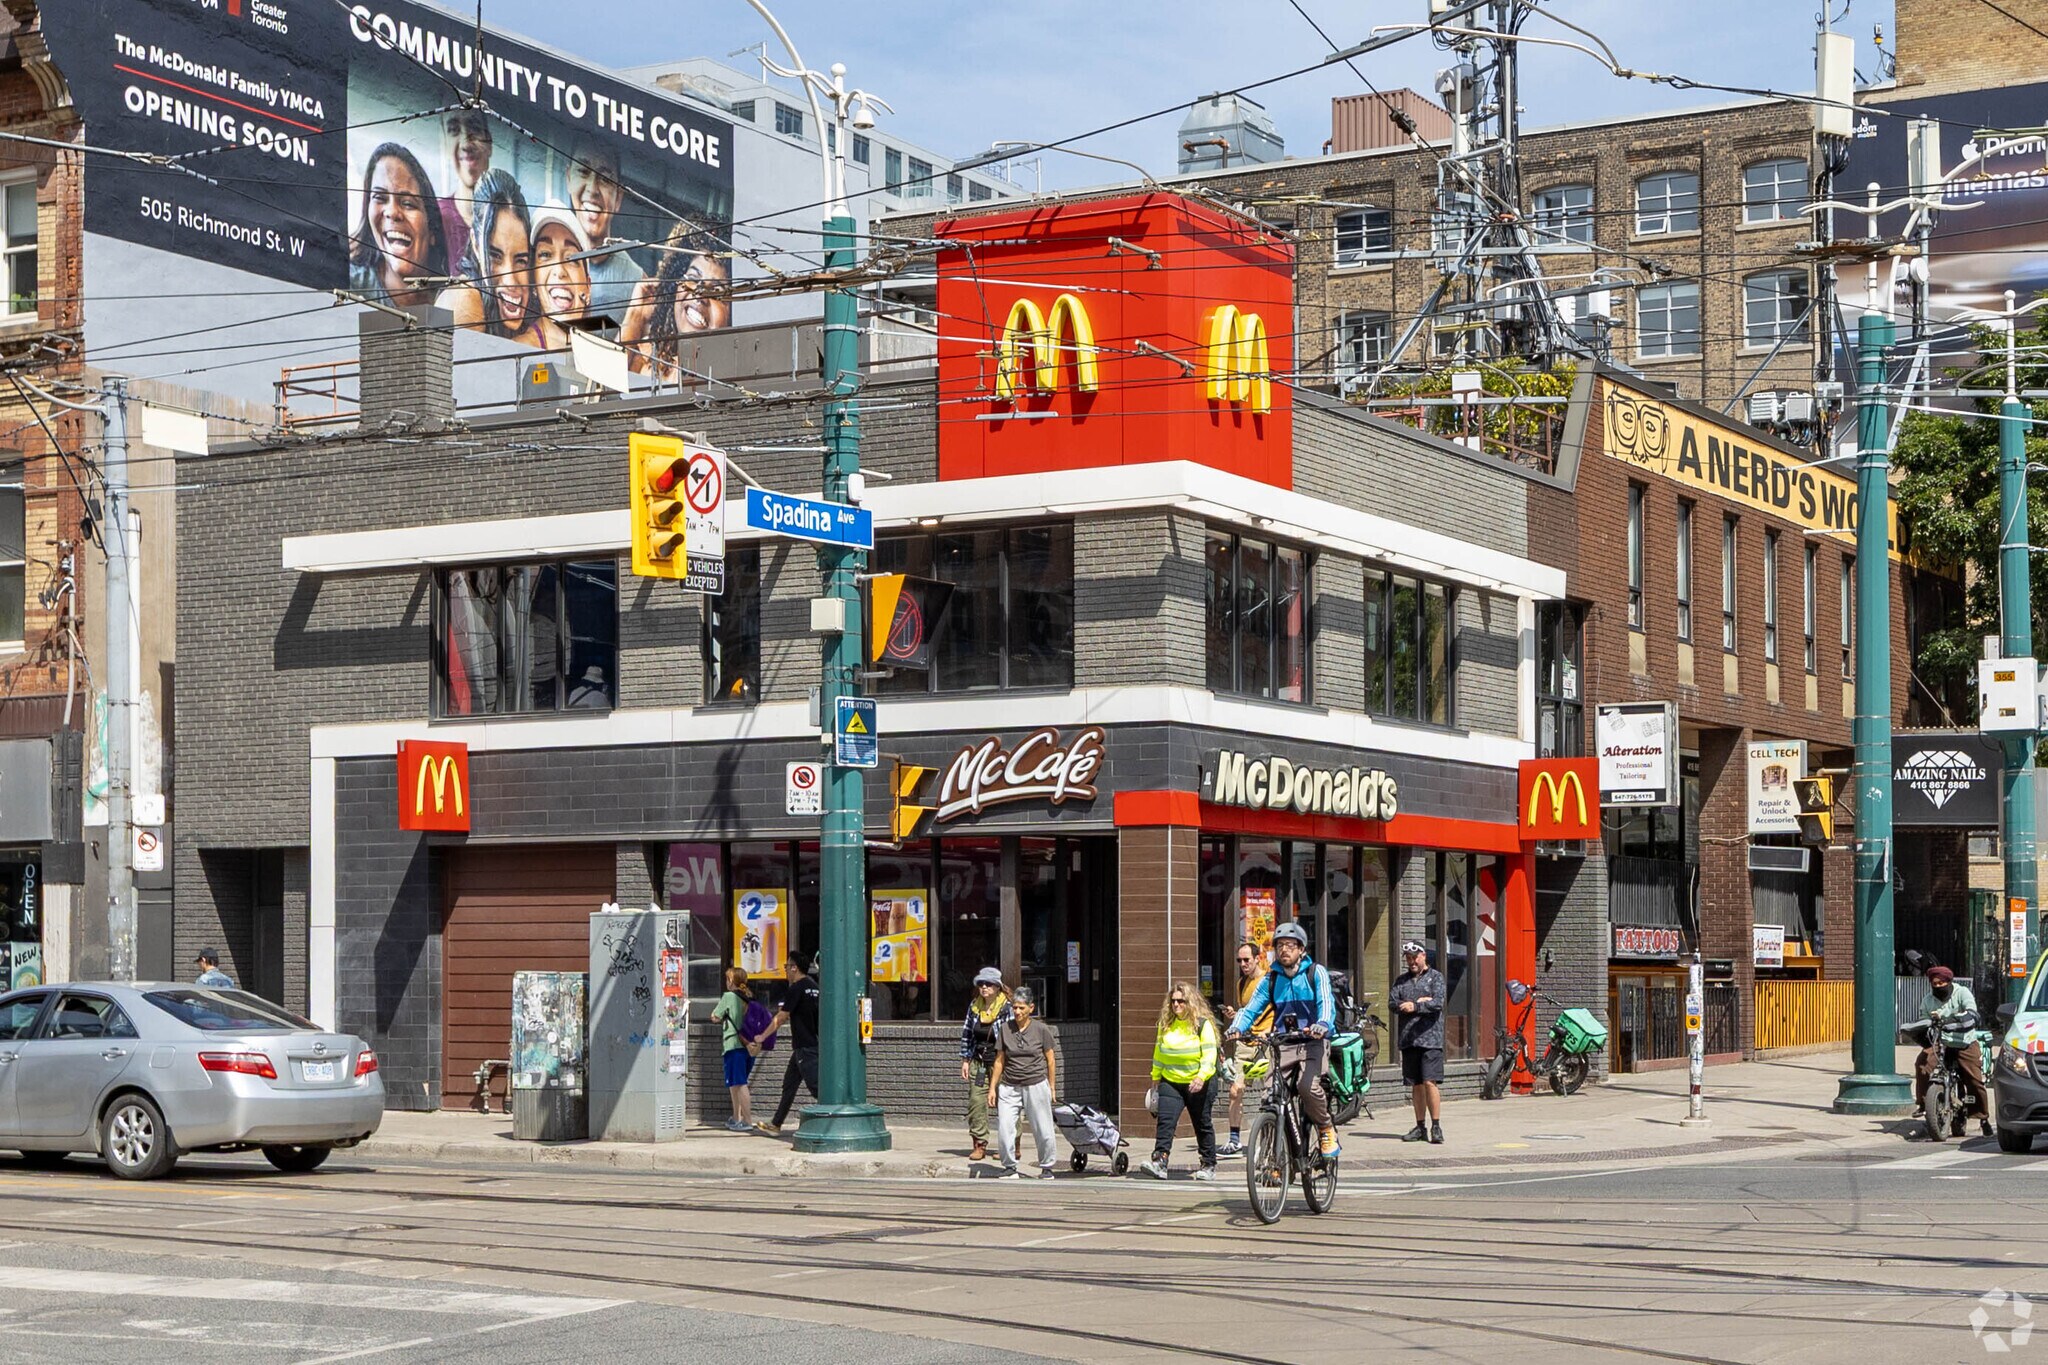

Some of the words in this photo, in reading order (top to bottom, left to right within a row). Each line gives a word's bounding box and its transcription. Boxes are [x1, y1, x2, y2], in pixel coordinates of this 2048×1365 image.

[251, 0, 287, 20] Greater
[250, 10, 288, 34] Toronto
[114, 33, 146, 61] The
[150, 46, 226, 88] McDonald
[230, 71, 278, 106] Family
[280, 88, 324, 119] YMCA
[349, 5, 541, 103] COMMUNITY
[547, 75, 587, 118] TO
[593, 93, 644, 142] THE
[650, 116, 720, 168] CORE
[124, 85, 236, 142] OPENING
[242, 121, 315, 166] SOON.
[140, 196, 173, 223] 505
[178, 205, 260, 246] Richmond
[265, 231, 285, 252] St.
[290, 236, 305, 258] W
[1677, 426, 1703, 479] A
[1707, 435, 1816, 520] NERD'S
[762, 494, 831, 532] Spadina
[837, 508, 855, 525] Ave
[693, 561, 724, 575] VEHICLES
[685, 575, 718, 589] EXCEPTED
[840, 701, 874, 710] ATTENTION
[1602, 744, 1663, 757] Alteration
[1750, 749, 1772, 758] CELL
[1774, 748, 1799, 757] TECH
[938, 731, 1100, 815] McCafé
[1615, 761, 1653, 769] Professional
[1893, 768, 1948, 780] AMAZING
[1951, 768, 1986, 780] NAILS
[1213, 749, 1398, 822] McDonald's
[1619, 772, 1647, 780] Tailoring
[1910, 781, 1927, 789] 416
[1758, 800, 1782, 808] Repair
[1783, 799, 1791, 807] &
[1761, 807, 1788, 815] Unlock
[1755, 816, 1795, 824] Accessories
[24, 863, 35, 924] OPEN
[740, 897, 762, 920] $2
[1615, 928, 1679, 951] TATTOOS
[14, 946, 37, 968] NEW
